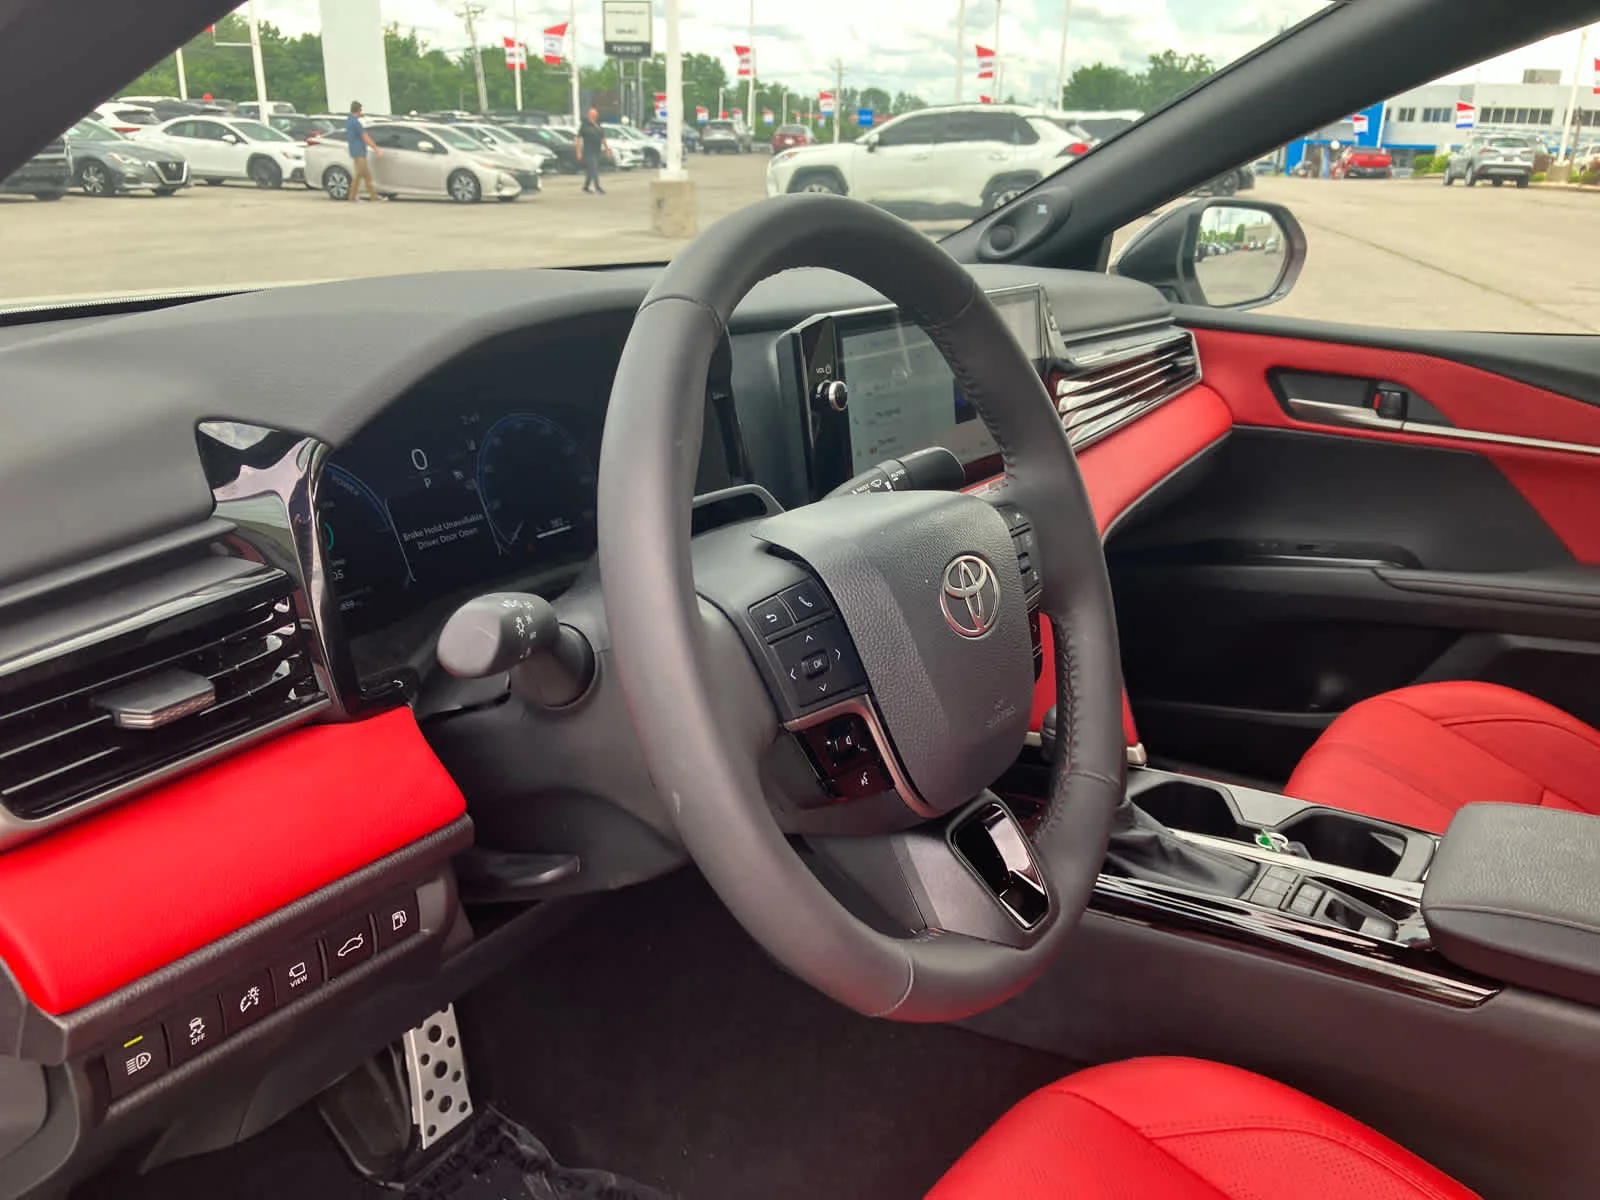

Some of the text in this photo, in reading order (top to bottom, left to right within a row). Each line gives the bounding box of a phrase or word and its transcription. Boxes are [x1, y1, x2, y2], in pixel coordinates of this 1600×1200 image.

[411, 448, 428, 470] 0
[423, 477, 432, 489] P
[402, 513, 484, 542] Brake Hold Unavailable
[417, 527, 478, 550] Driver Door Open
[290, 975, 308, 987] VIEW
[191, 1033, 206, 1045] OFF
